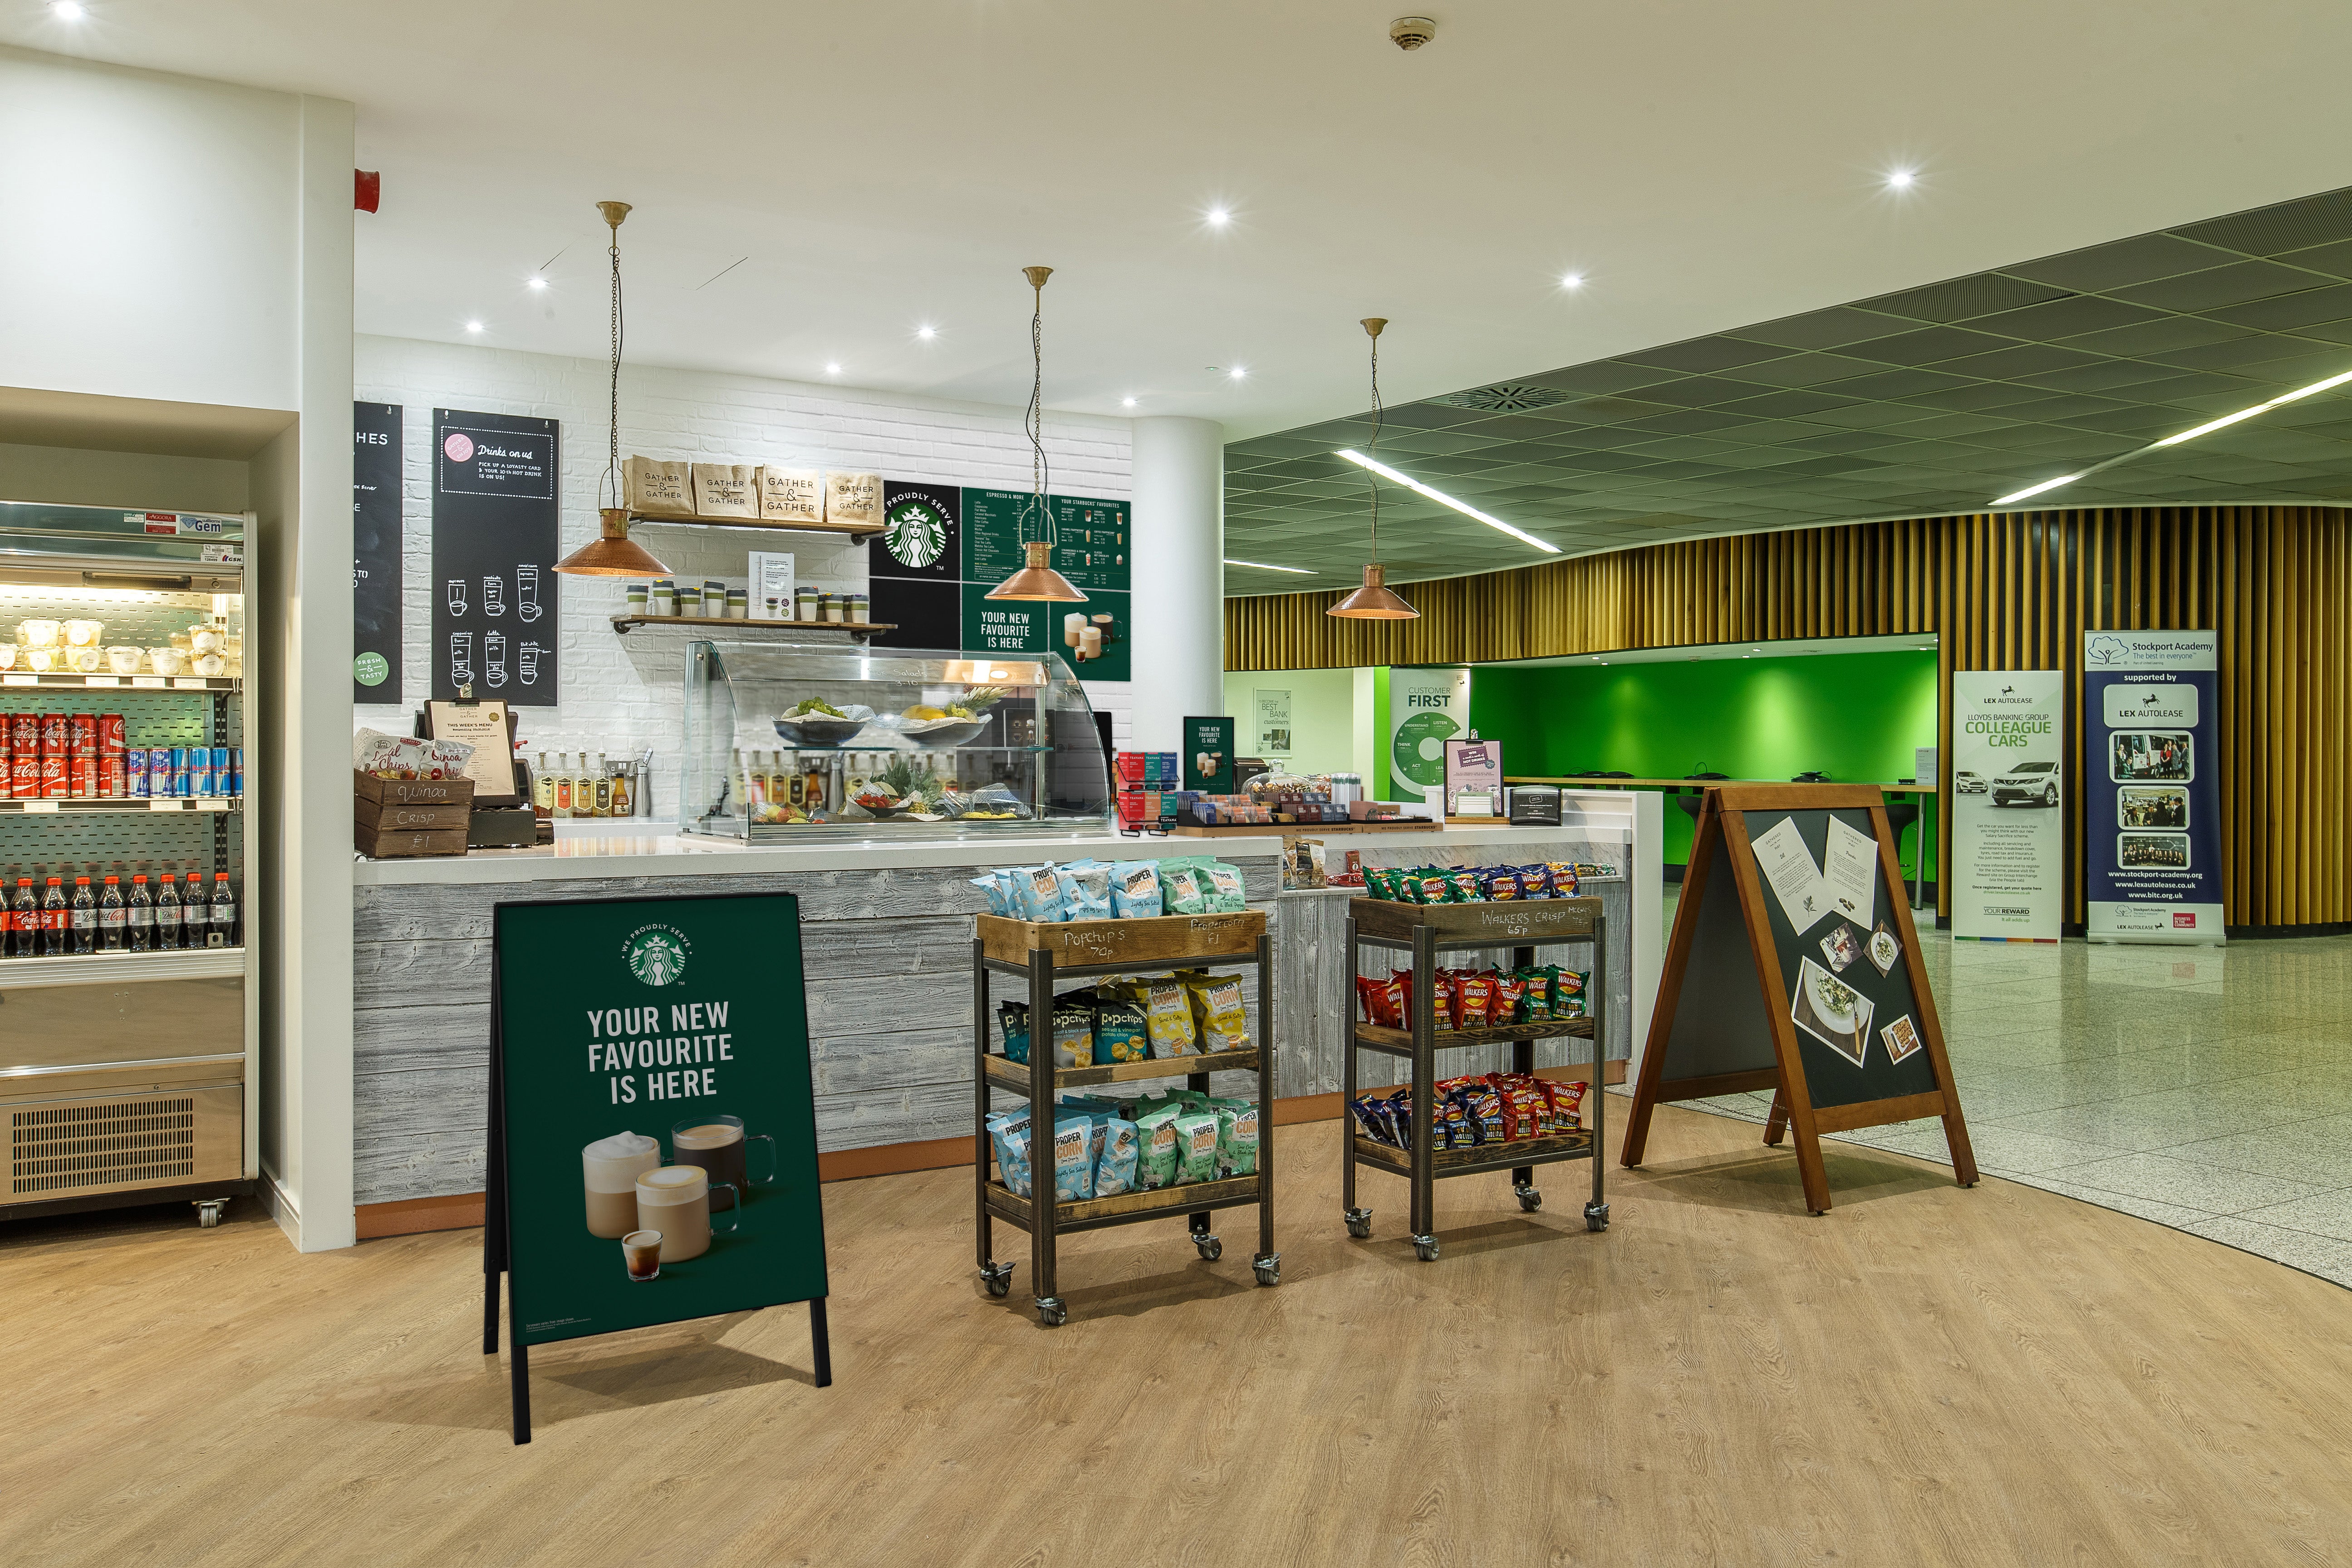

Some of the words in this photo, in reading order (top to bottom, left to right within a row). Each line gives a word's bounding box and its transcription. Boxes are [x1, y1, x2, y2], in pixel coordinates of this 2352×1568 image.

[447, 436, 465, 451] GATHER
[457, 446, 471, 459] ENJOY
[478, 445, 507, 457] Drinks
[645, 473, 680, 482] GATHER
[768, 477, 813, 489] GATHER
[767, 502, 814, 512] GATHER
[887, 492, 929, 507] PROUDLY
[931, 499, 953, 526] SERVE
[195, 521, 221, 532] Gem
[982, 611, 1006, 623] YOUR
[1010, 613, 1029, 624] NEW
[981, 624, 1030, 636] FAVOURITE
[988, 637, 997, 647] IS
[1000, 637, 1023, 649] HERE
[2132, 643, 2173, 652] Stockport
[2175, 642, 2213, 652] Academy
[893, 668, 927, 677] Salads
[1409, 695, 1451, 707] FIRST
[1965, 722, 2052, 734] COLLEAGUE
[1989, 735, 2028, 747] CARS
[379, 756, 412, 774] Chips
[1766, 832, 1781, 845] GATHERED
[1843, 831, 1861, 843] GATHERED
[1126, 869, 1152, 885] PROPER
[1553, 874, 1575, 885] WALKERS
[1128, 878, 1156, 895] CORN
[1422, 880, 1446, 892] WALKERS
[1493, 882, 1517, 891] WALKERS
[622, 940, 631, 952] WE
[630, 924, 668, 939] PROUDLY
[670, 927, 691, 947] SERVE
[1558, 975, 1582, 987] WALKERS
[1151, 983, 1177, 995] PROPER
[1465, 988, 1488, 997] WALKERS
[1152, 991, 1180, 1006] CORN
[587, 1007, 660, 1037] YOUR
[672, 1001, 728, 1031] NEW
[1102, 1013, 1142, 1027] popchips
[589, 1033, 733, 1072] FAVOURITE
[611, 1075, 636, 1104] IS
[648, 1068, 717, 1101] HERE
[1554, 1086, 1581, 1098] WALKERS
[1193, 1124, 1215, 1137] PROPER
[1056, 1132, 1081, 1147] PROPER
[1193, 1132, 1215, 1150] CORN
[1056, 1141, 1083, 1159] CORN
